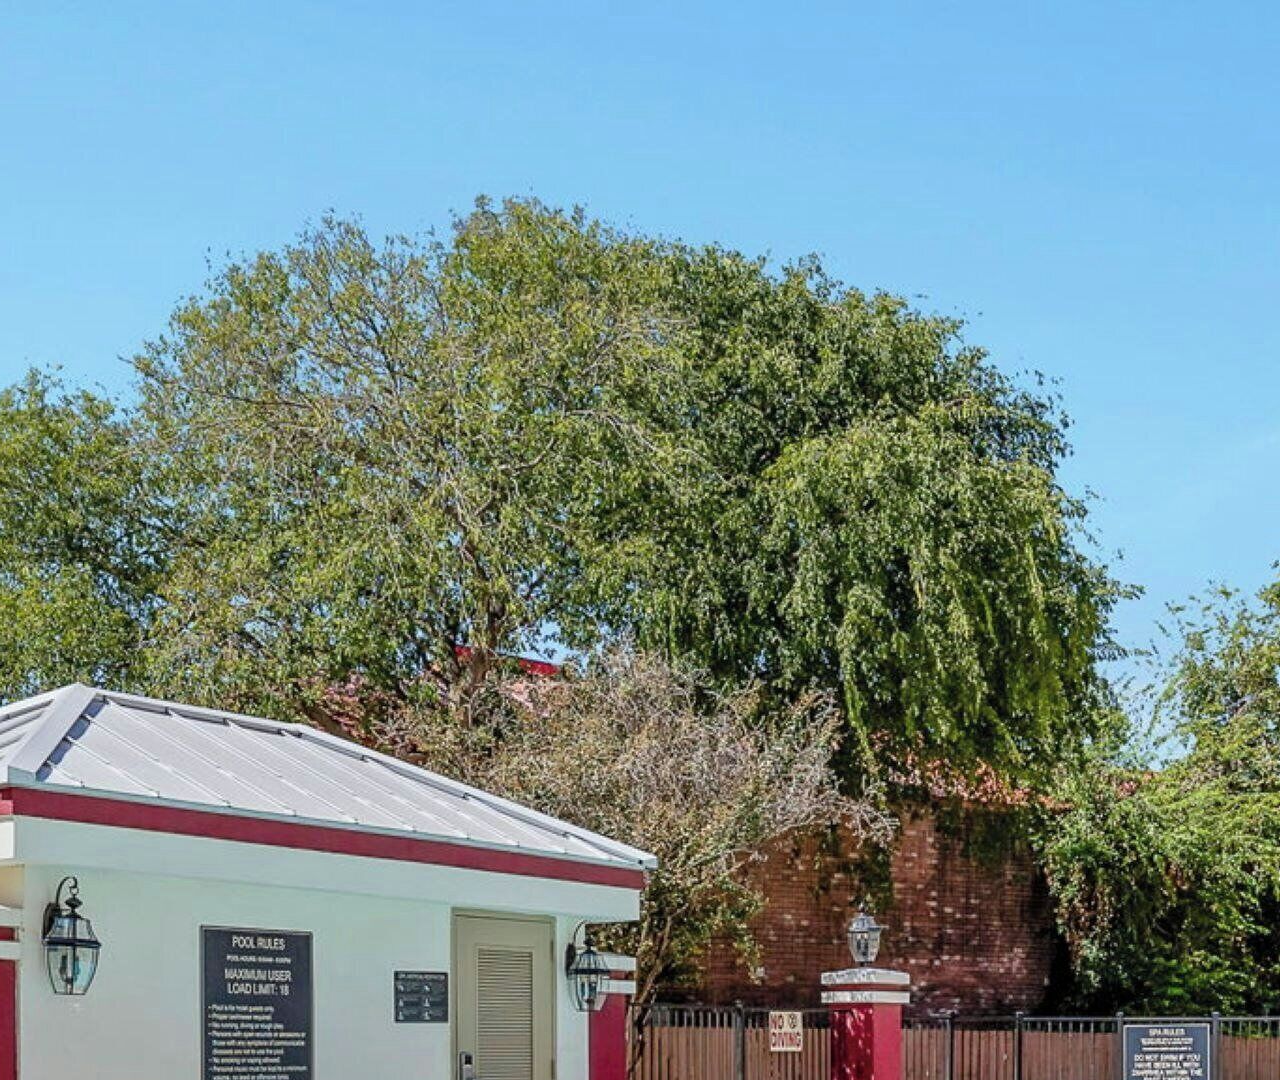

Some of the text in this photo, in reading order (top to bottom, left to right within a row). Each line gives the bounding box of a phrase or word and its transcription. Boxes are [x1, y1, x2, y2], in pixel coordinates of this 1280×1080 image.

[232, 935, 286, 951] POOL RULES
[225, 968, 291, 982] MAXIMUM USER
[227, 982, 252, 994] LOAD
[771, 1013, 784, 1029] NO
[772, 1031, 801, 1047] DIVING
